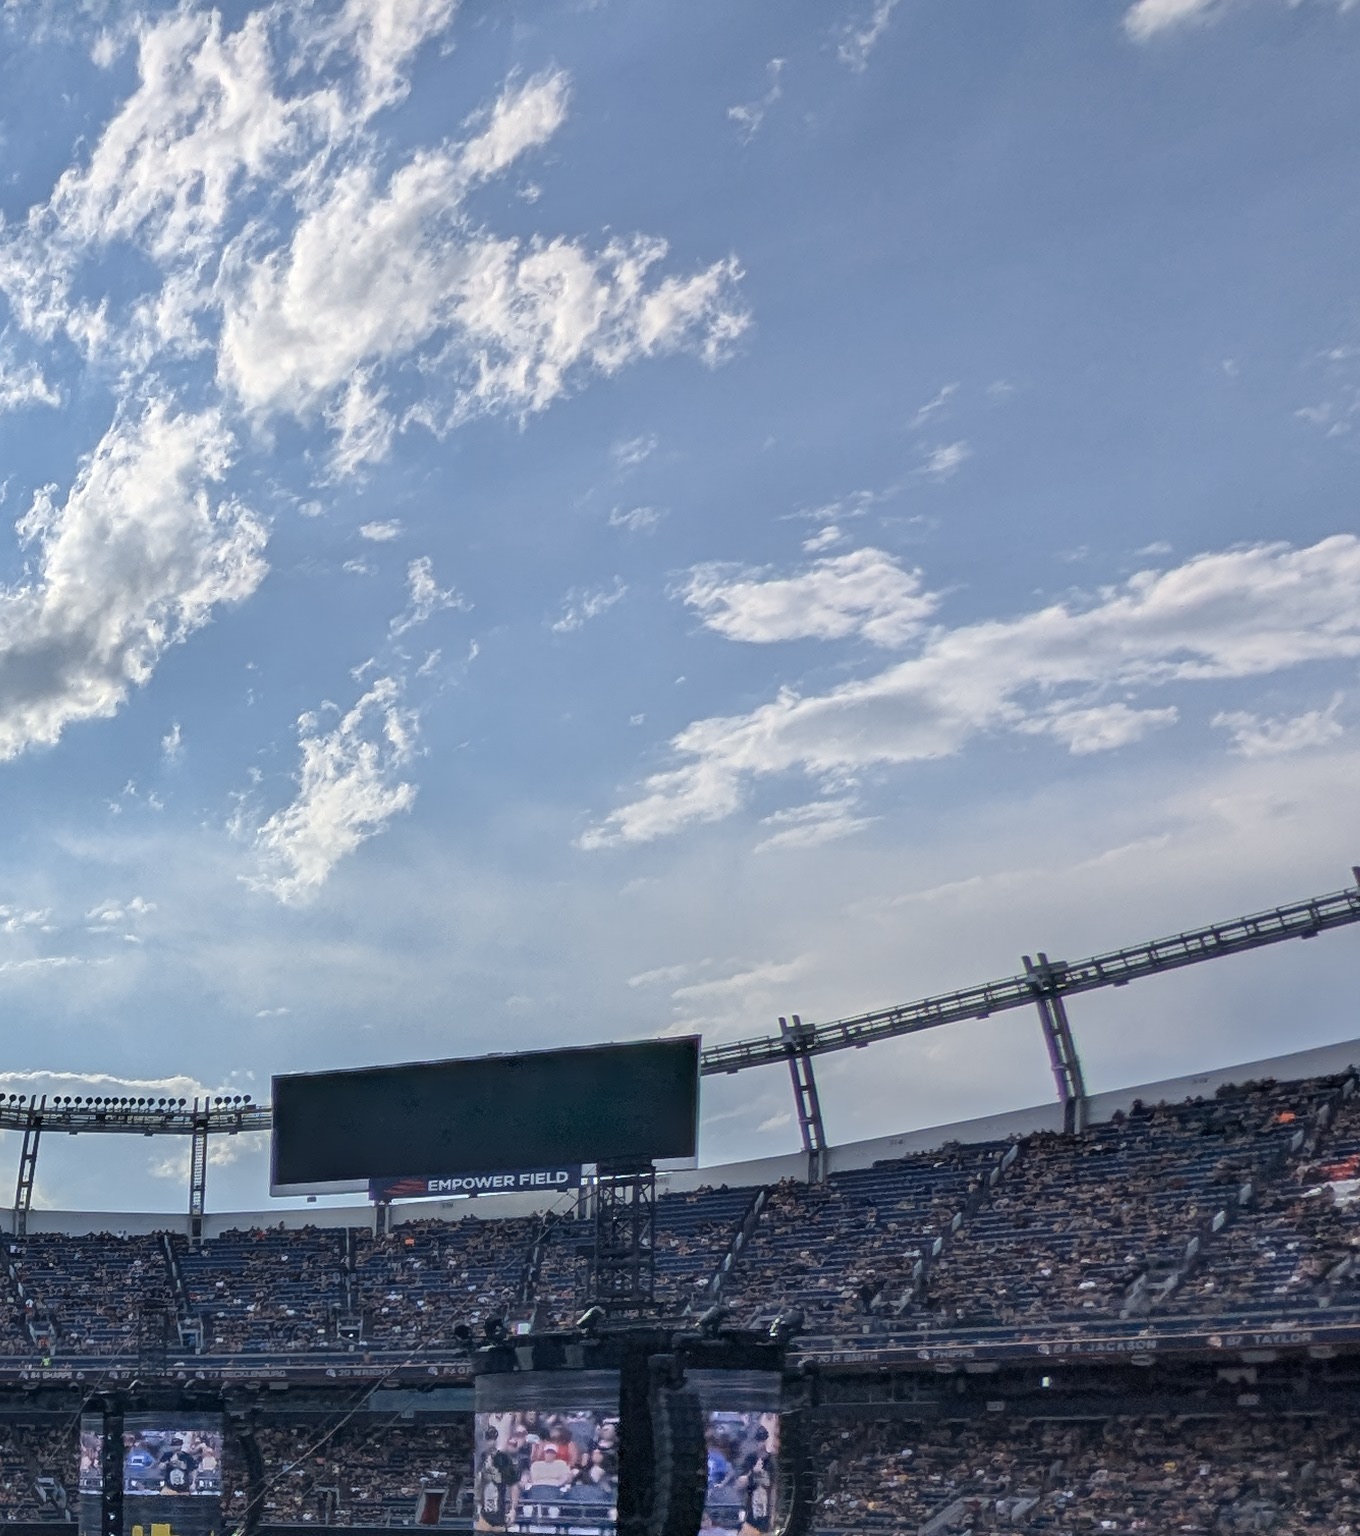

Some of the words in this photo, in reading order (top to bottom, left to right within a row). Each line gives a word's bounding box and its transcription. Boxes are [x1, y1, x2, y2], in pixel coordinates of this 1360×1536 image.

[427, 1174, 515, 1192] EMPOWER
[519, 1171, 569, 1186] FIELD
[1254, 1333, 1313, 1345] TAYLOR
[1086, 1340, 1157, 1352] JACKSON
